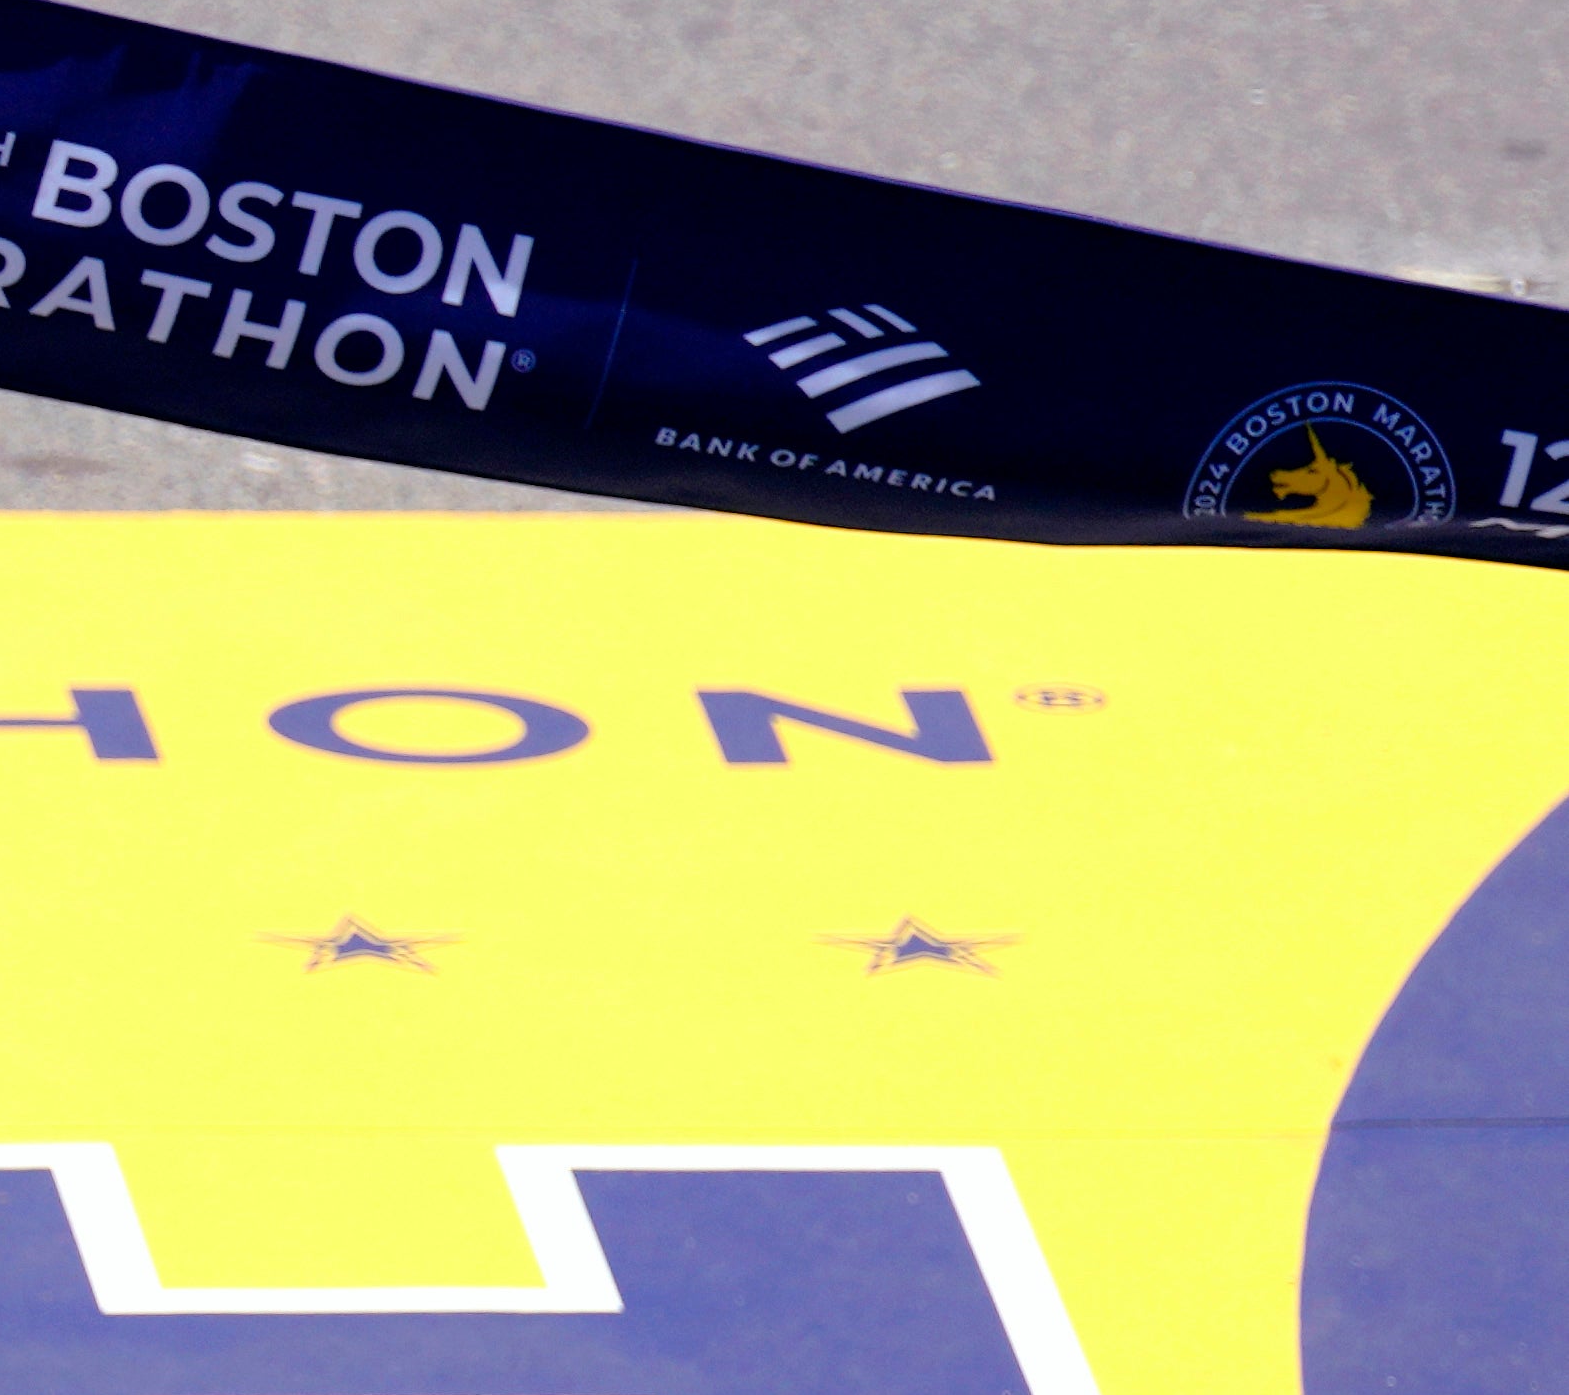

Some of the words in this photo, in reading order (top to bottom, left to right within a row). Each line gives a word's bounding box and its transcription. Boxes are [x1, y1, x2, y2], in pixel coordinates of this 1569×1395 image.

[32, 139, 534, 318] BOSTON
[1226, 391, 1355, 455] BOSTON
[654, 427, 761, 462] BANK
[769, 449, 819, 471] OF
[824, 459, 997, 502] AMERICA
